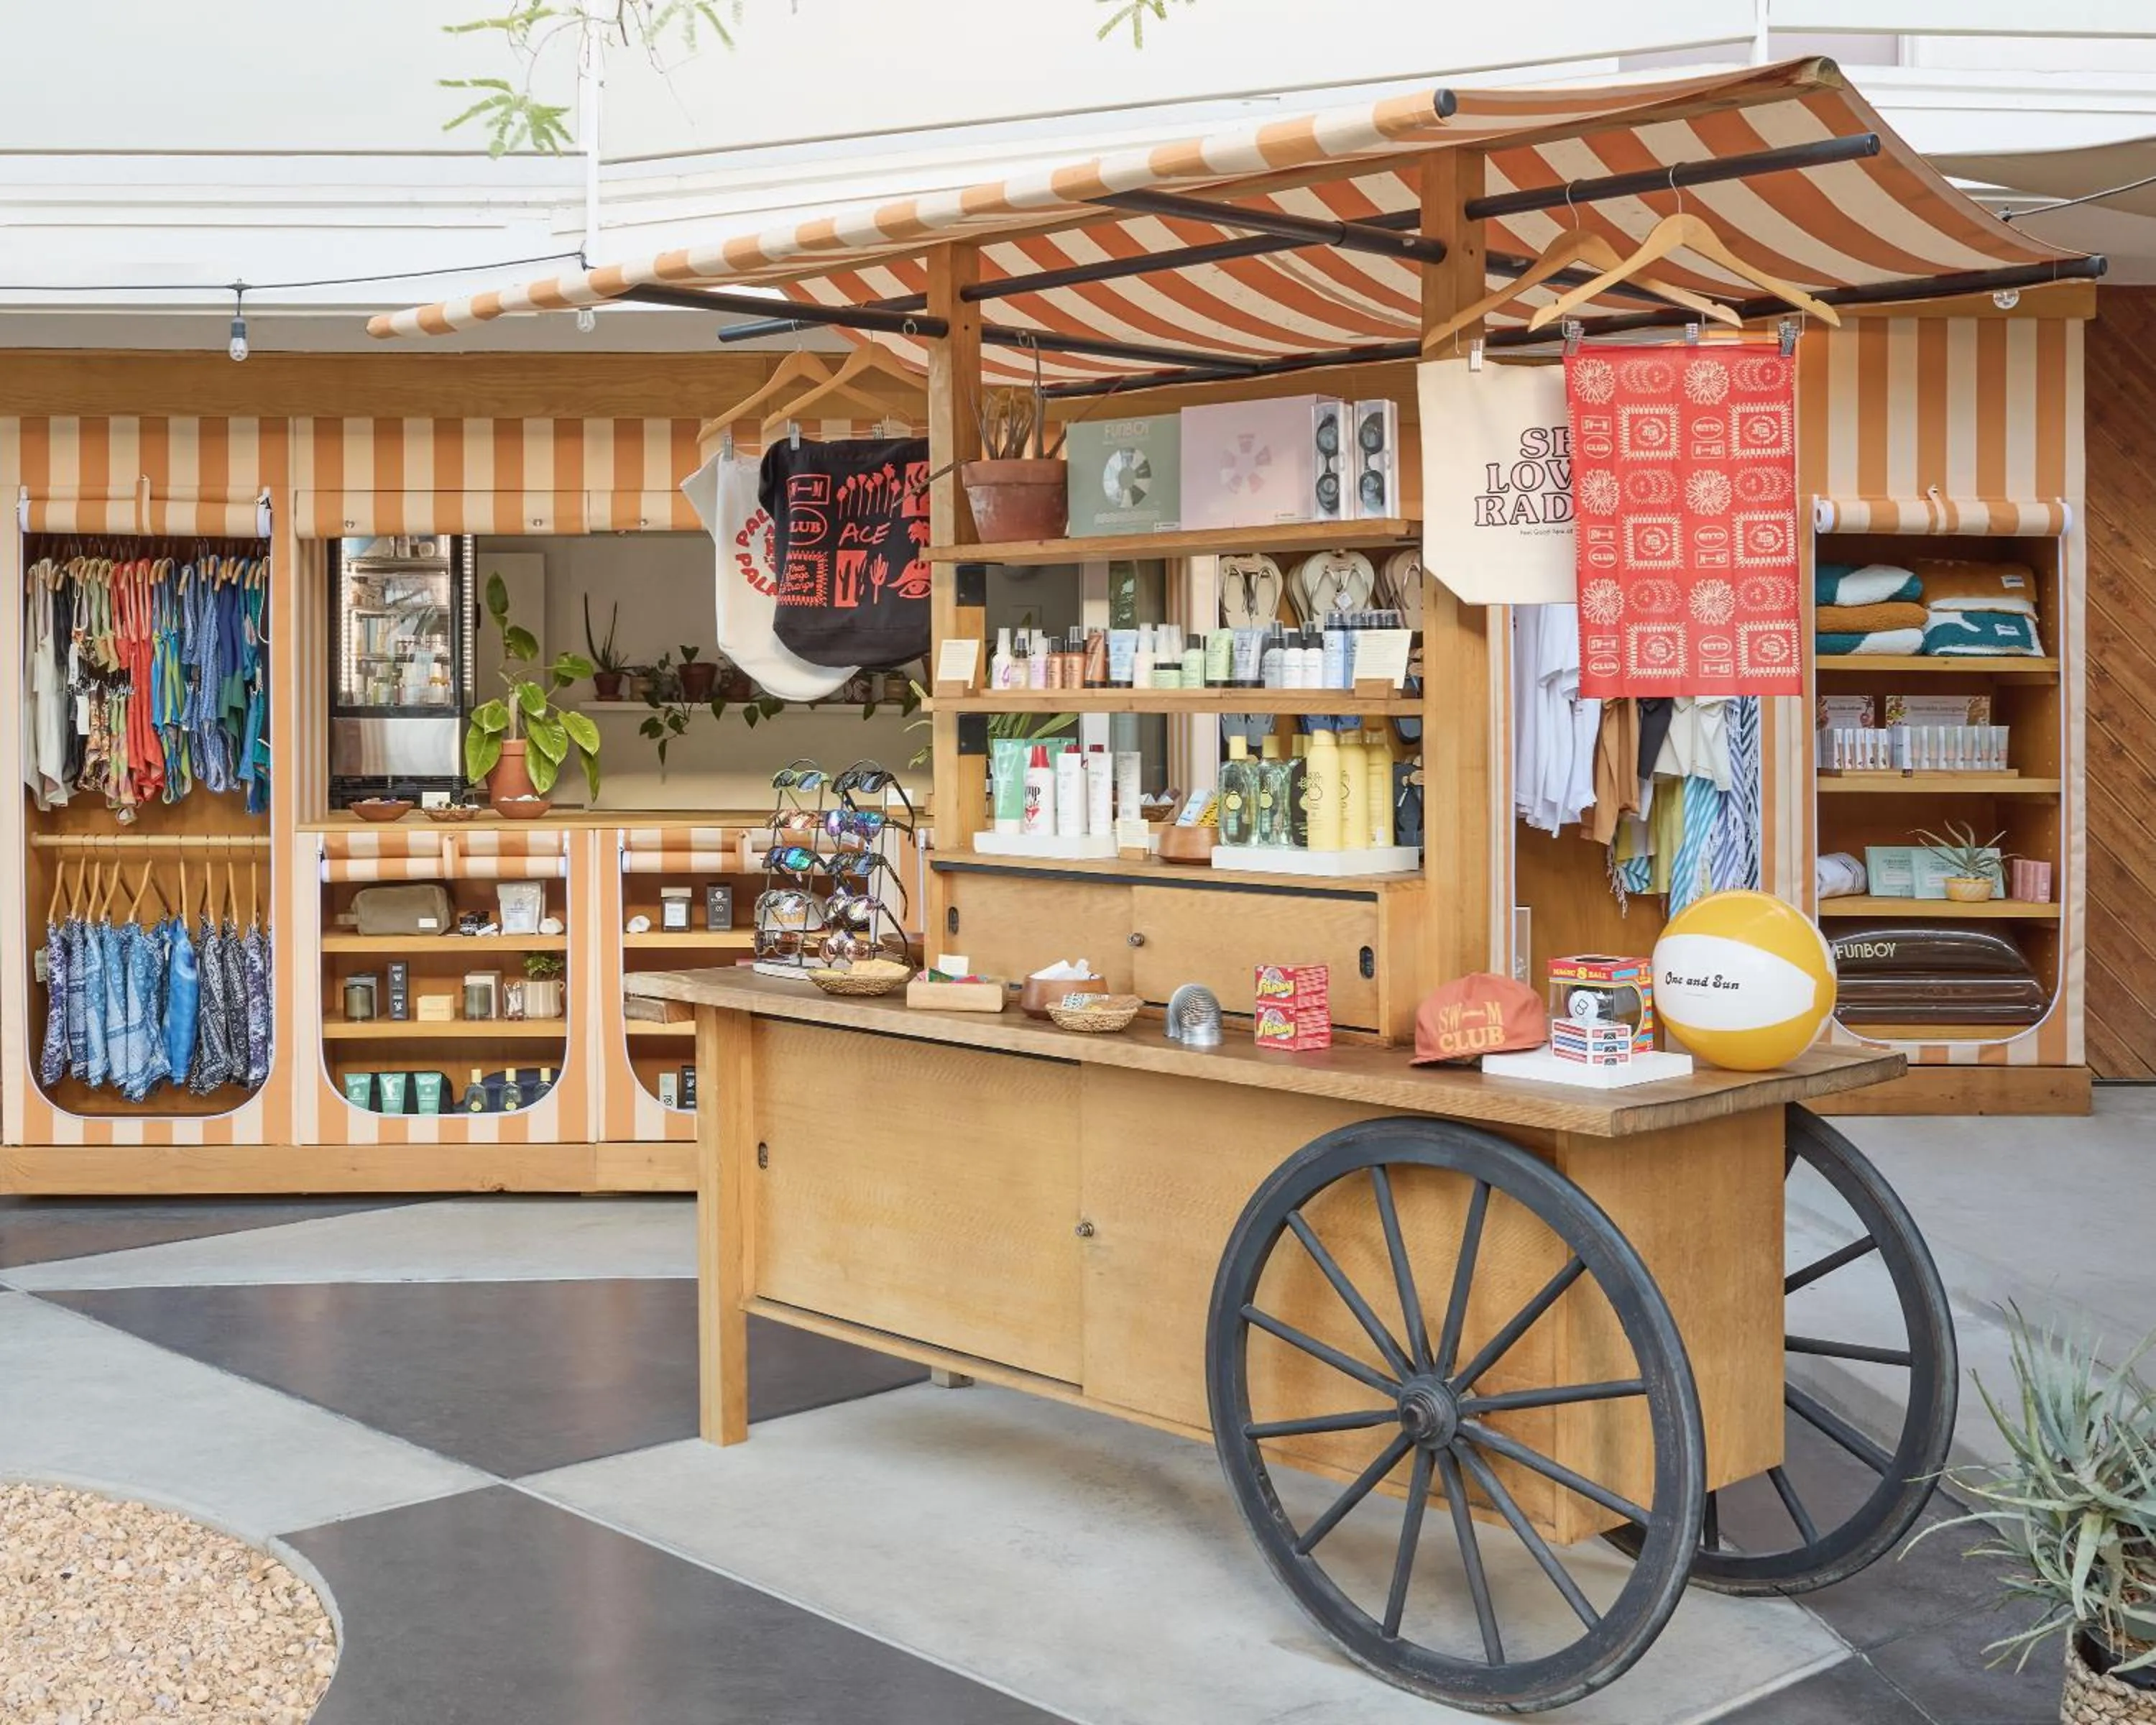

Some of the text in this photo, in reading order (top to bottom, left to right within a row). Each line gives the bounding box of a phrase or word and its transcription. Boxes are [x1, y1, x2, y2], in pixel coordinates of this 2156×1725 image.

[791, 521, 821, 533] LUB
[838, 522, 891, 547] ACE
[1577, 967, 1588, 980] 8
[1665, 972, 1682, 985] One
[1687, 976, 1709, 987] and
[1713, 974, 1739, 989] Sun
[1439, 1025, 1506, 1052] CLUB
